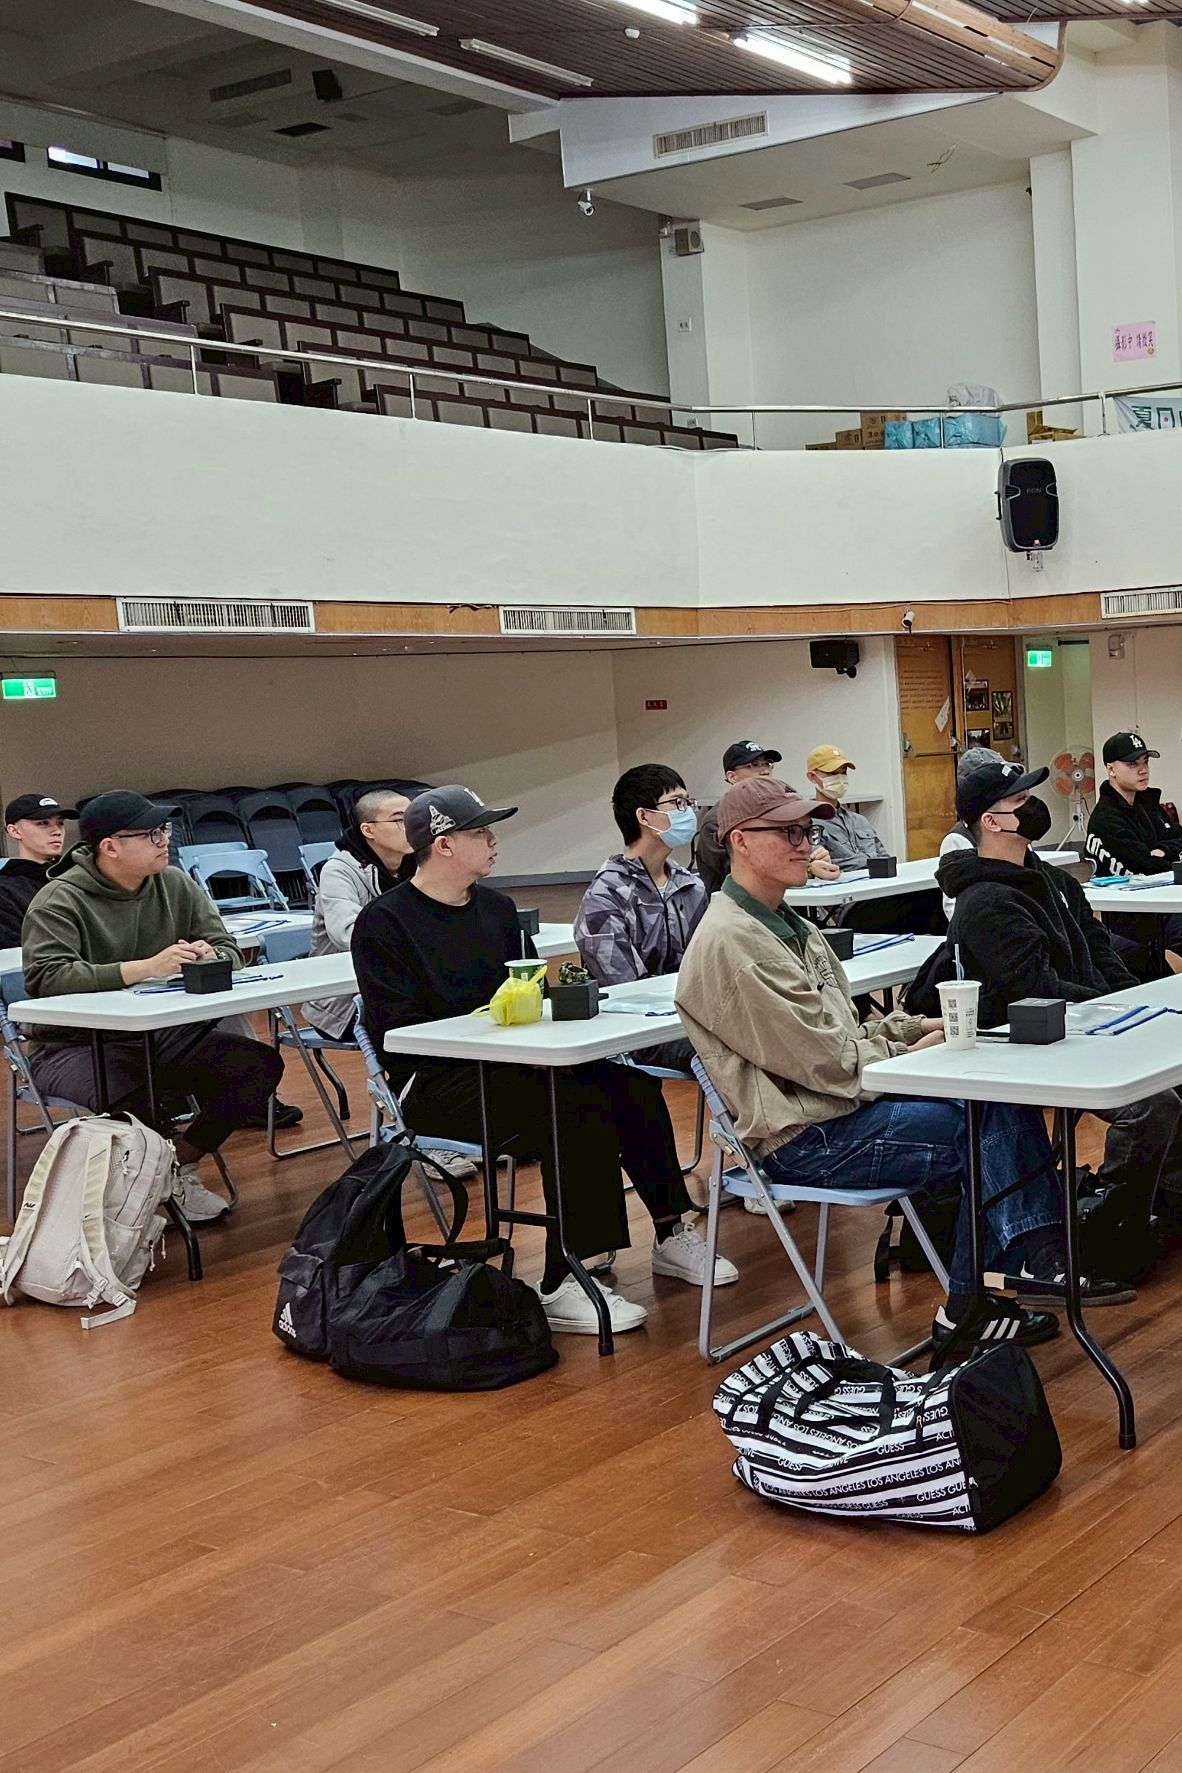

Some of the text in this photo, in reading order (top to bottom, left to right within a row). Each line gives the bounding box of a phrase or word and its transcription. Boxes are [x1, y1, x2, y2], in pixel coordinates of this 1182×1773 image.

[771, 1412, 793, 1427] ANG
[922, 1405, 949, 1422] GUES
[794, 1423, 809, 1435] LOS
[809, 1428, 846, 1446] ANGELES
[876, 1442, 905, 1455] GUESS
[813, 1488, 829, 1497] LOS
[829, 1481, 866, 1496] ANGELES
[867, 1477, 884, 1489] LOS
[884, 1468, 924, 1484] ANGELES
[926, 1463, 944, 1474] LOS
[945, 1458, 962, 1470] AN
[916, 1487, 947, 1502] GUESS
